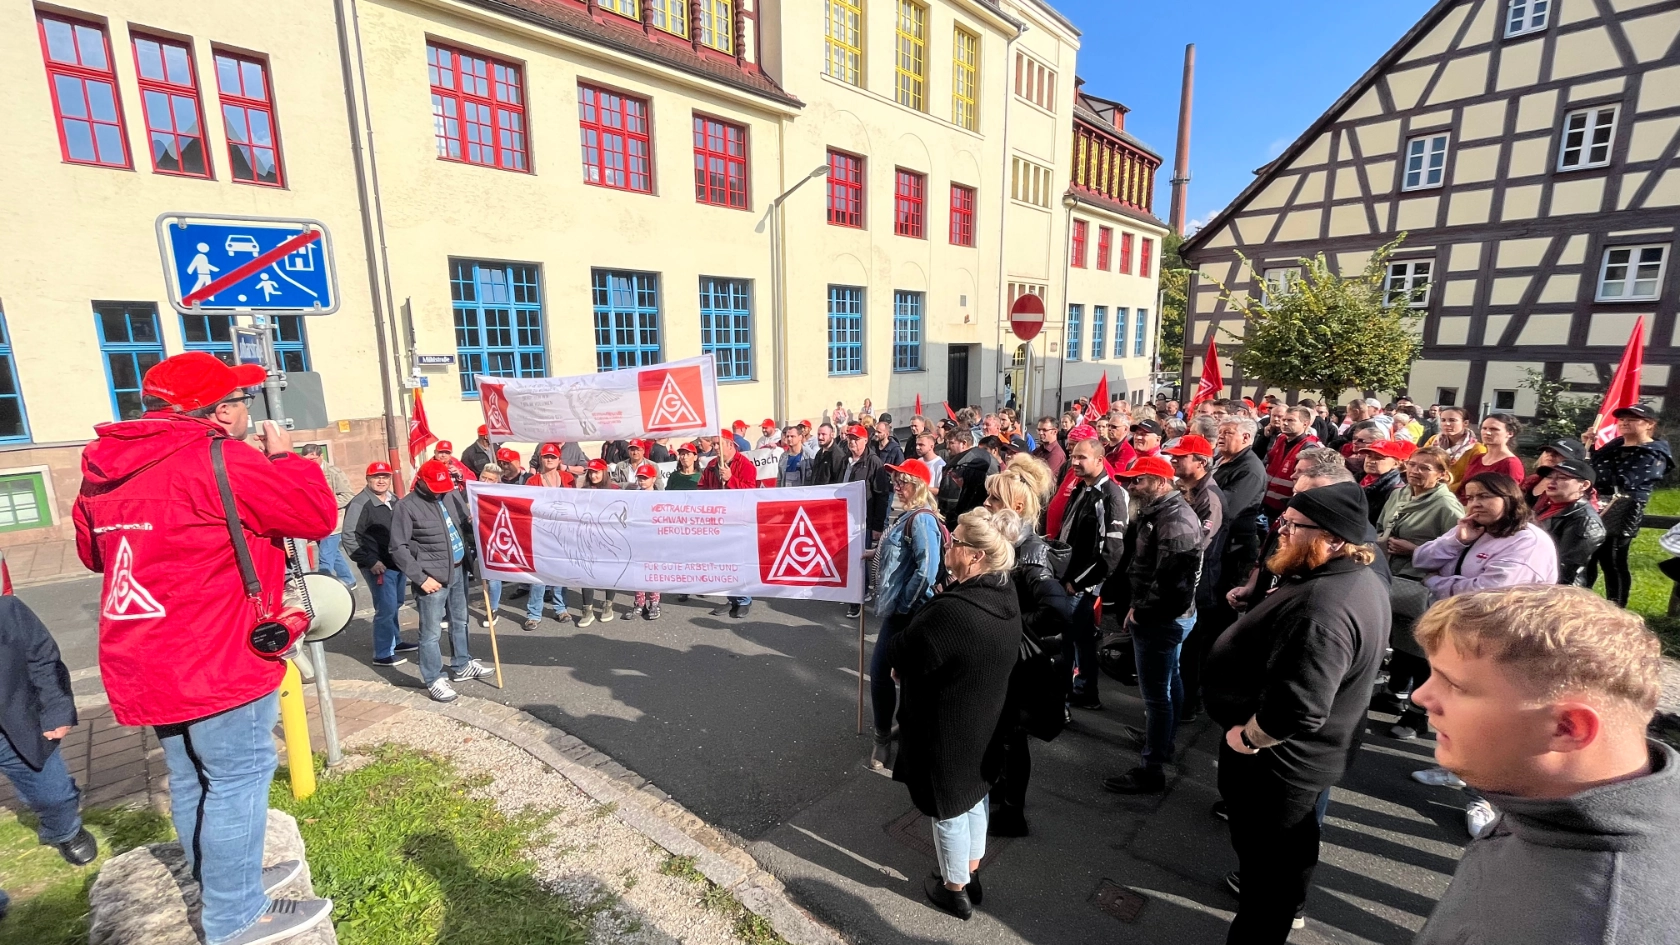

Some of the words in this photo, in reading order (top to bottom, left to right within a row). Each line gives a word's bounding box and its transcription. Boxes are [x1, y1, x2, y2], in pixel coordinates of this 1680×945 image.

[651, 504, 727, 514] VERTRAUENSLEUTE
[690, 517, 725, 525] STABILO
[657, 527, 720, 535] HEROLDSBERG
[662, 562, 683, 570] GUTE
[645, 574, 739, 582] LEBENSBEDINGUNGEN
